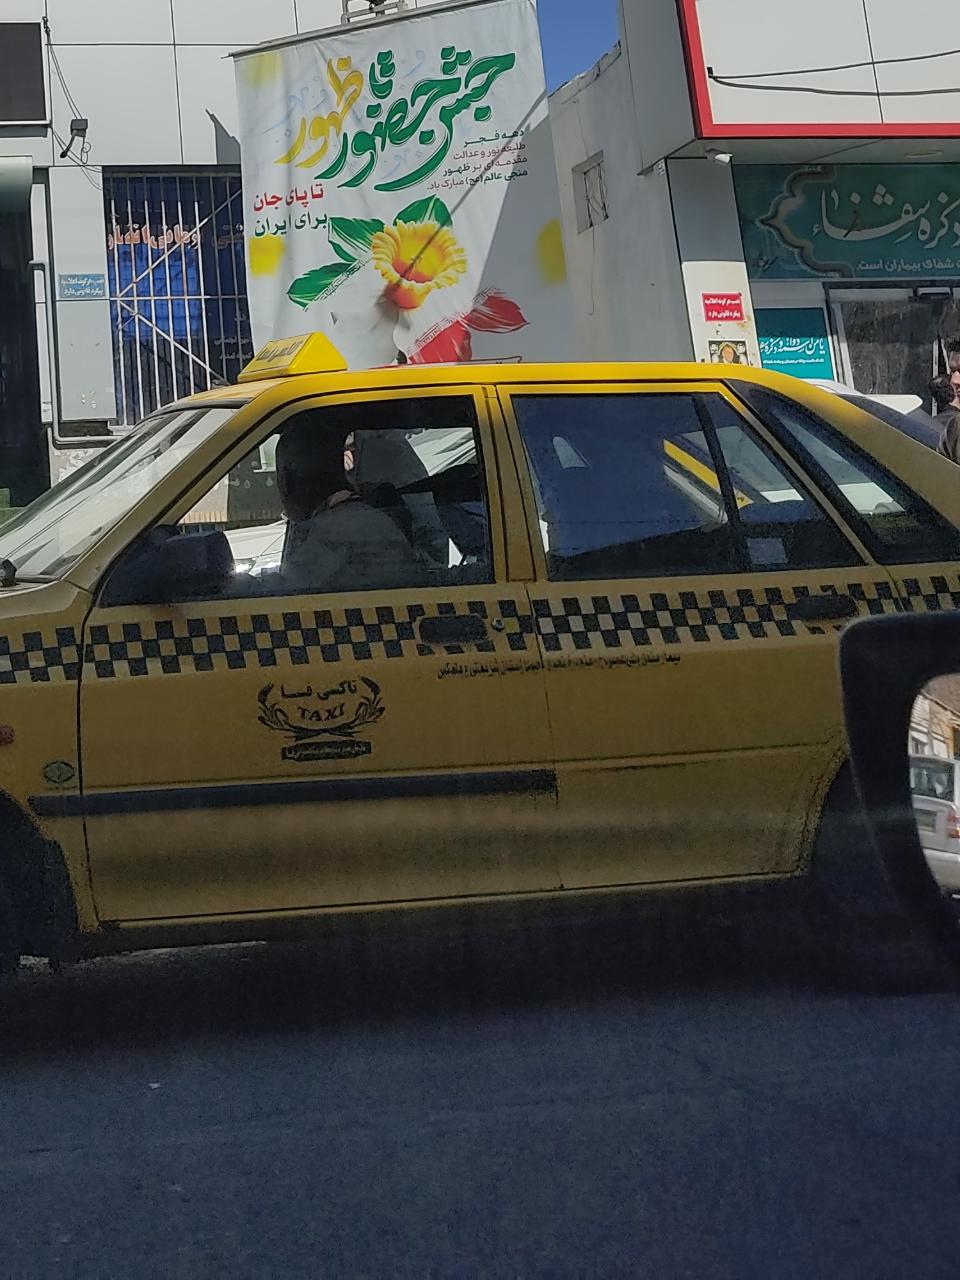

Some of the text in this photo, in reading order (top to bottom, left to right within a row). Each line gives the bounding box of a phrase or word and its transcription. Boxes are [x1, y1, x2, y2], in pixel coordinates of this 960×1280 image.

[369, 49, 396, 100] تا
[442, 161, 471, 177] ظهور
[253, 183, 324, 212] تا پای جان
[254, 213, 292, 237] ایران
[294, 211, 328, 230] برای
[297, 702, 346, 723] TAXI
